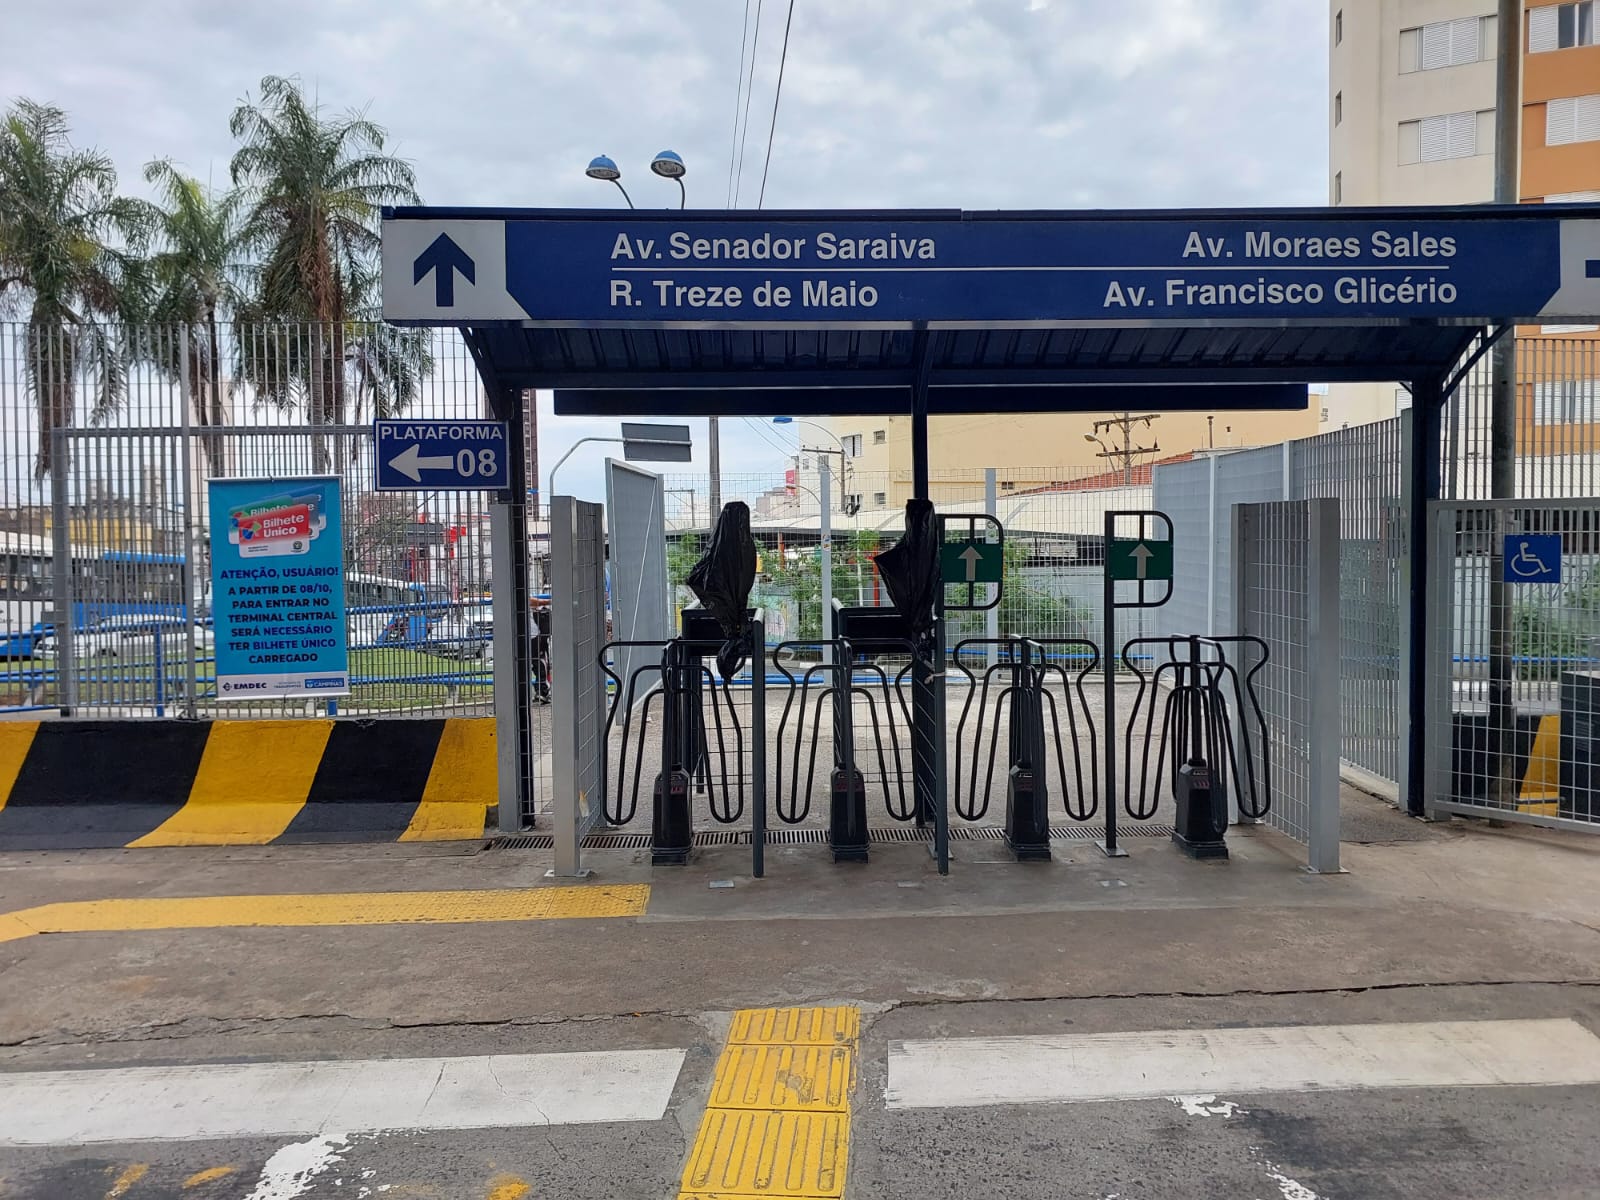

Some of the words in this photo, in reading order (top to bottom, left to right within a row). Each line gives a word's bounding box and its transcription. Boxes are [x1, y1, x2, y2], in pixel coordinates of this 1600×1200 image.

[611, 233, 662, 259] Av.
[669, 231, 806, 260] Senador
[816, 232, 936, 260] Saraiva
[1182, 231, 1233, 258] Av.
[1245, 231, 1361, 258] Moraes
[1371, 230, 1457, 258] Sales
[610, 279, 642, 306] R.
[653, 280, 743, 307] Treze
[752, 280, 792, 307] de
[803, 280, 879, 307] Maio
[1103, 281, 1154, 307] Av.
[1166, 277, 1324, 306] Francisco
[1334, 276, 1457, 304] Glicério
[381, 426, 503, 440] PLATAFORMA
[456, 448, 498, 477] 08
[263, 514, 305, 529] Bilhete
[220, 566, 280, 581] ATENÇÃO,
[282, 564, 339, 578] USUÁRIO!
[228, 587, 236, 595] A
[239, 585, 279, 595] PARTIR
[282, 585, 297, 594] DE
[299, 583, 332, 594] 08/10,
[232, 600, 263, 609] PARA
[265, 598, 310, 608] ENTRAR
[312, 598, 329, 606] NO
[228, 613, 285, 623] TERMINAL
[287, 611, 338, 621] CENTRAL
[231, 625, 261, 637] SERÁ
[264, 624, 333, 636] NECESSÁRIO
[228, 641, 250, 651] TER
[253, 640, 298, 650] BILHETE
[301, 637, 336, 649] ÚNICO
[248, 653, 319, 664] CARREGADO
[234, 682, 267, 690] EMDEC
